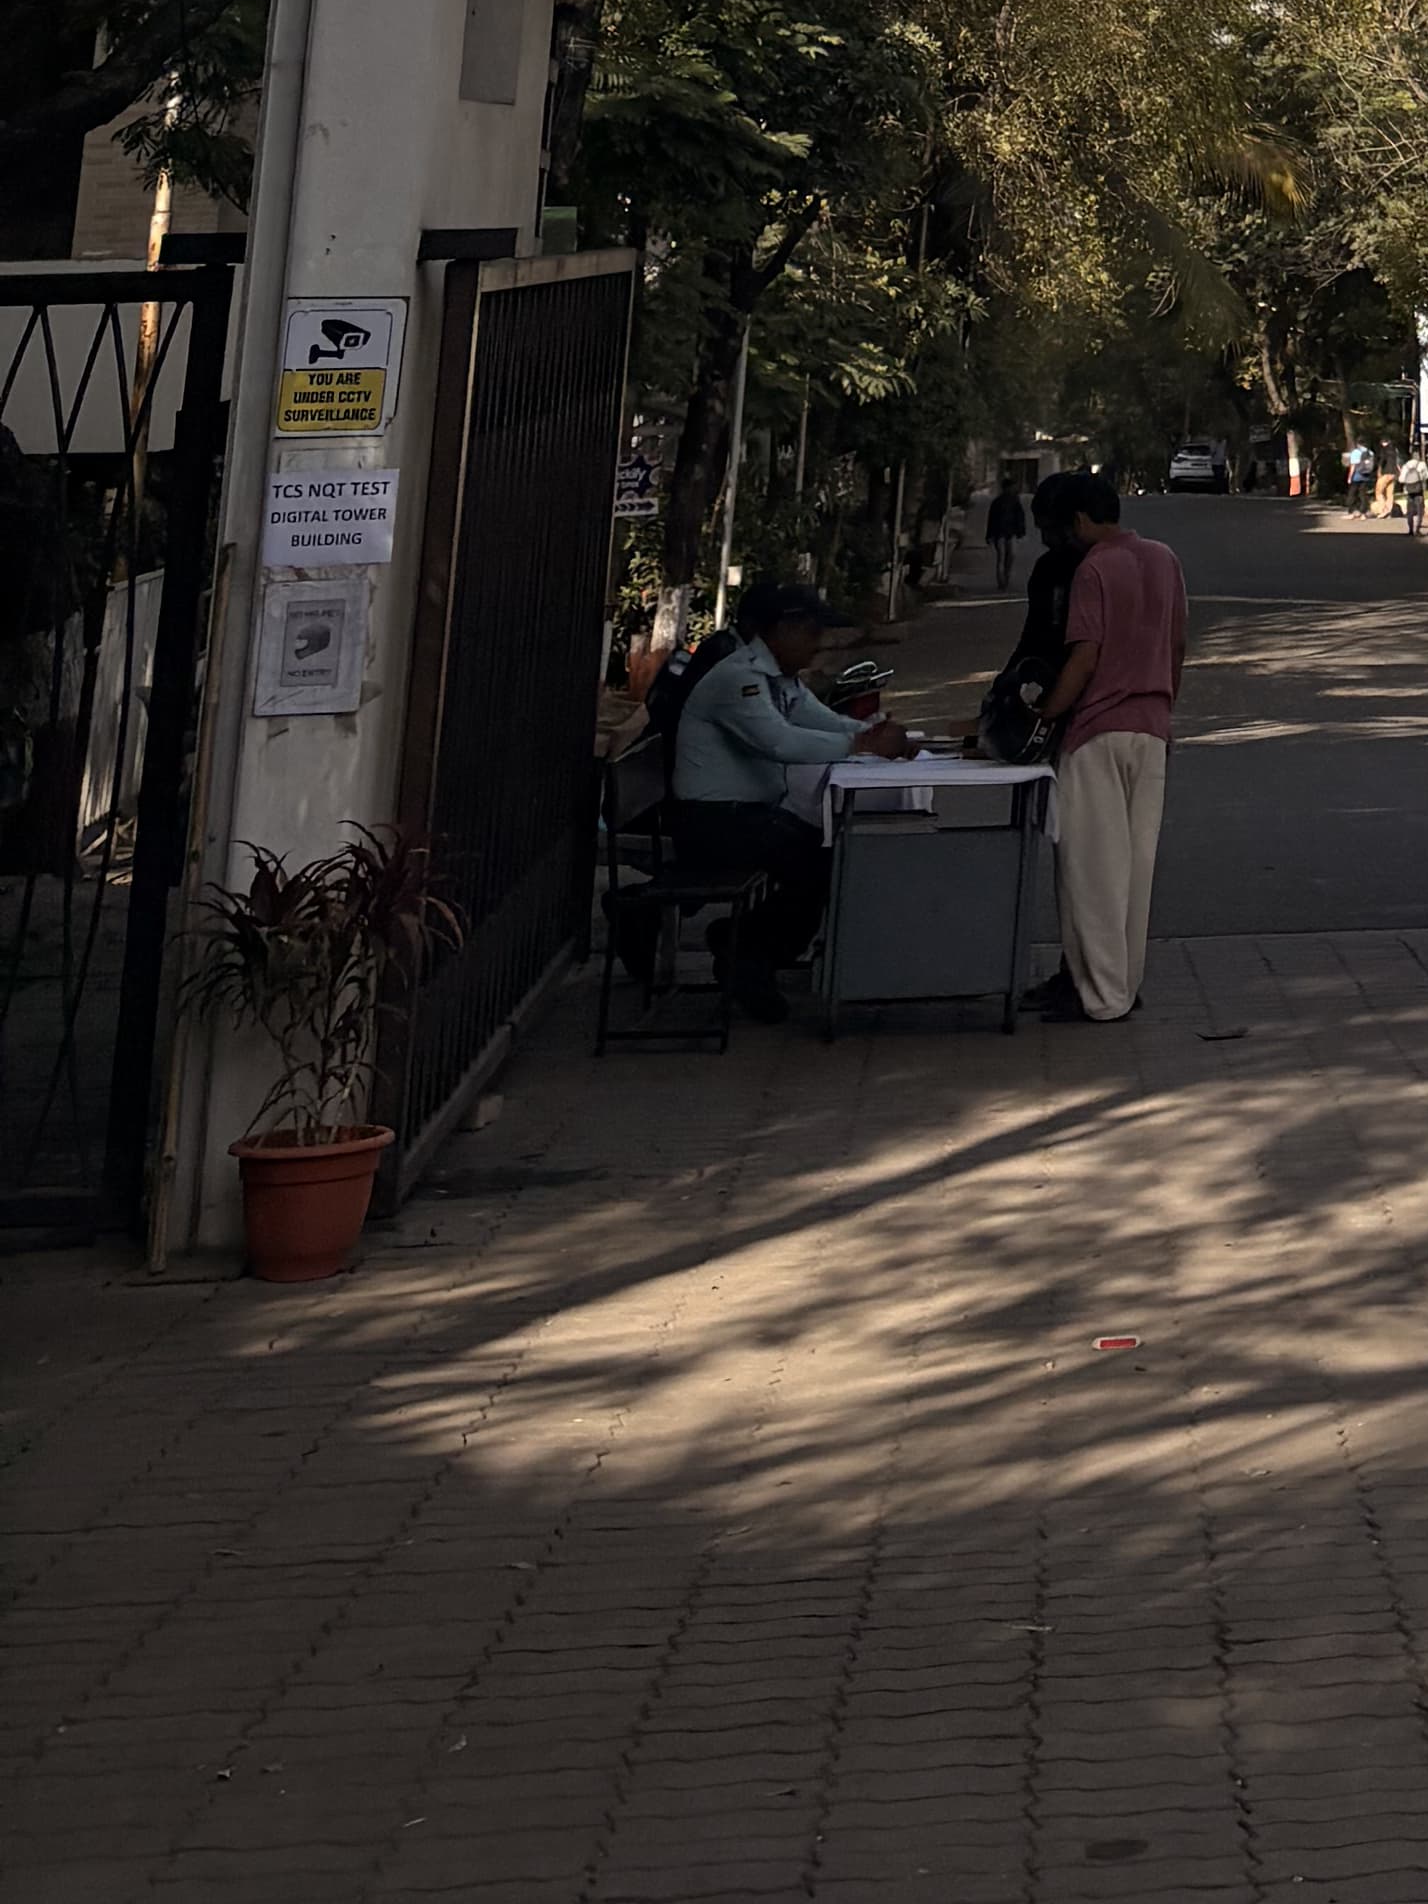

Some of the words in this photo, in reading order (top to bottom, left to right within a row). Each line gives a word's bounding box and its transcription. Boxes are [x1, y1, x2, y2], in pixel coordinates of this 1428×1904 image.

[307, 372, 333, 386] YOU
[335, 372, 361, 386] ARE
[293, 391, 335, 405] UNDER
[337, 390, 372, 404] CCTV
[283, 407, 376, 423] SURVEILLANCE
[272, 483, 304, 499] TCS
[307, 482, 347, 500] NQT
[350, 481, 390, 497] TEST
[270, 510, 329, 525] DIGITAL
[333, 507, 387, 522] TOWER
[290, 532, 362, 547] BUILDING
